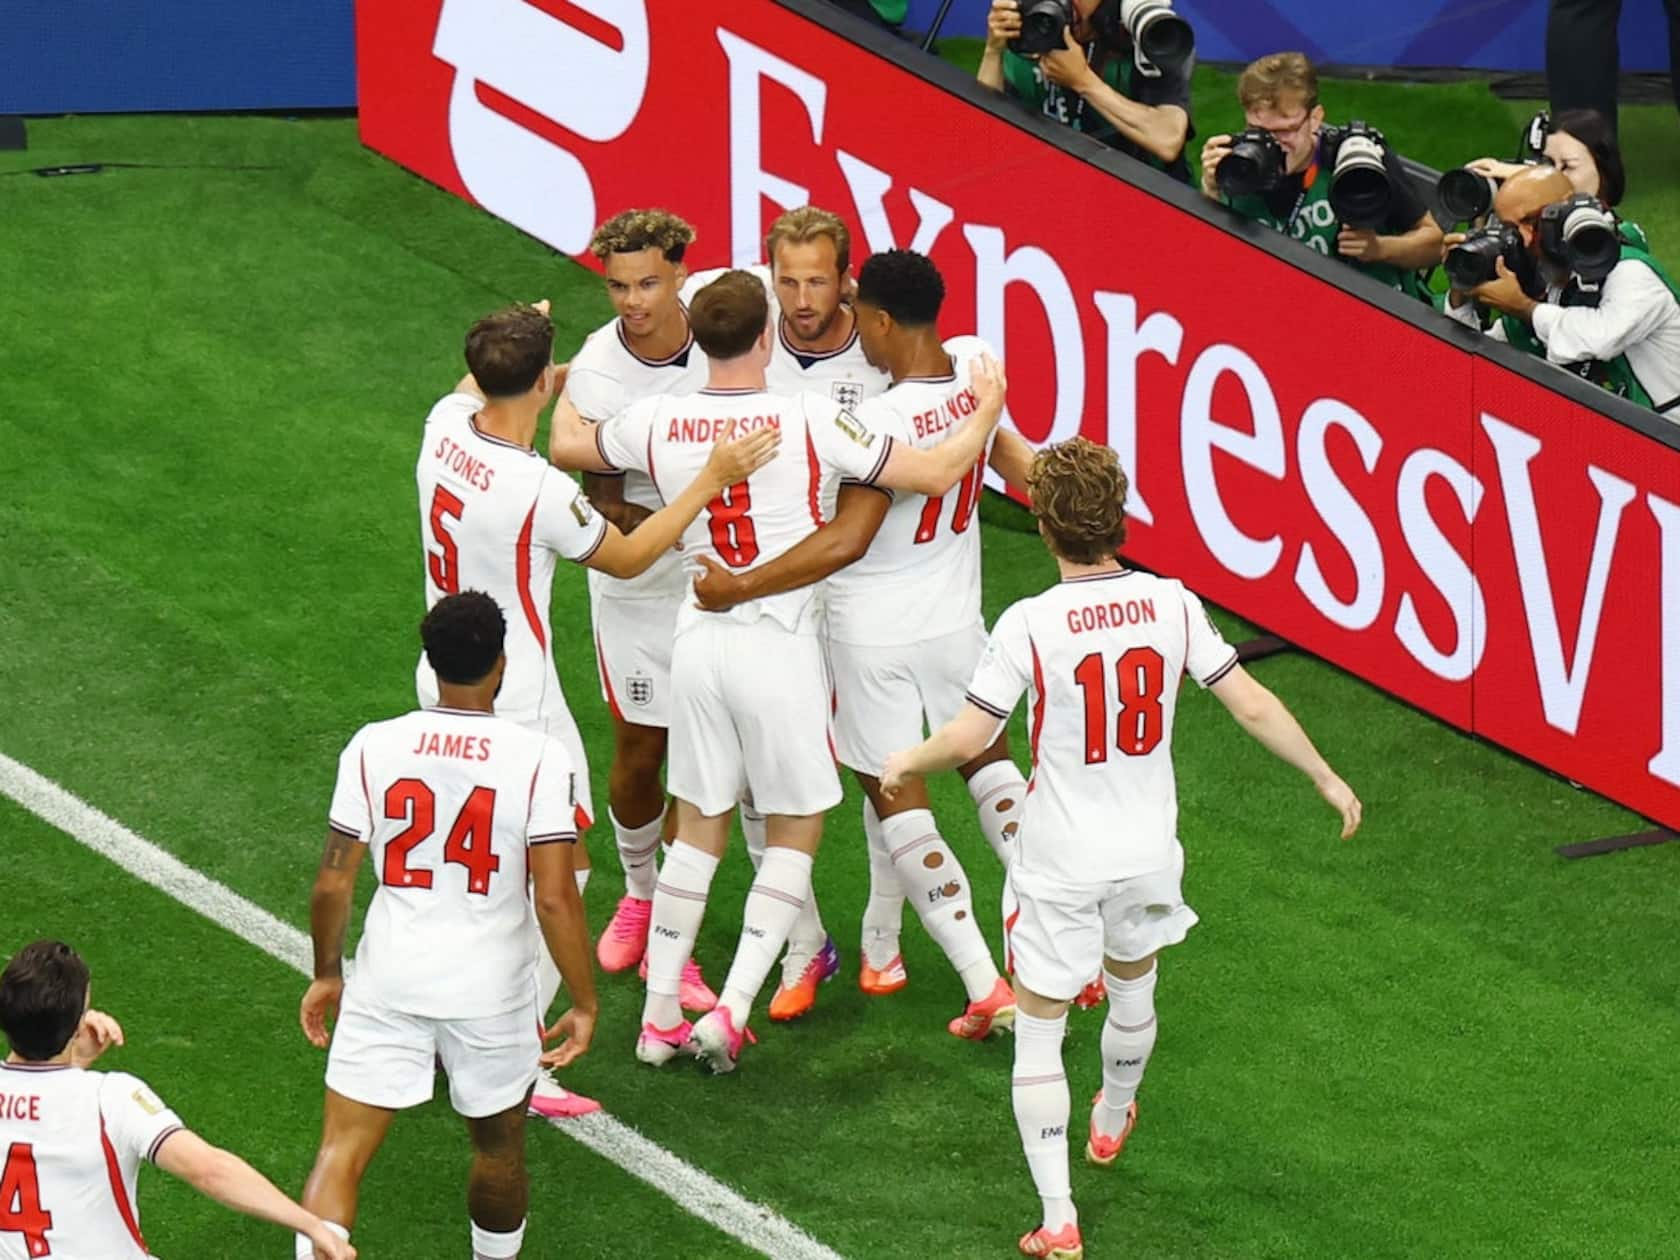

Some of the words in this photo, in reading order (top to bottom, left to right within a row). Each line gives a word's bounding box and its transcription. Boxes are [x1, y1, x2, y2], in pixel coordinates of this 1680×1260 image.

[435, 437, 495, 492] STONES
[428, 483, 465, 596] 5
[705, 478, 760, 568] 8
[1067, 598, 1157, 634] GORDON
[413, 732, 491, 762] JAMES
[1073, 645, 1164, 765] 18
[382, 777, 499, 896] 24
[1041, 1125, 1064, 1140] ENG
[0, 1142, 53, 1259] 4
